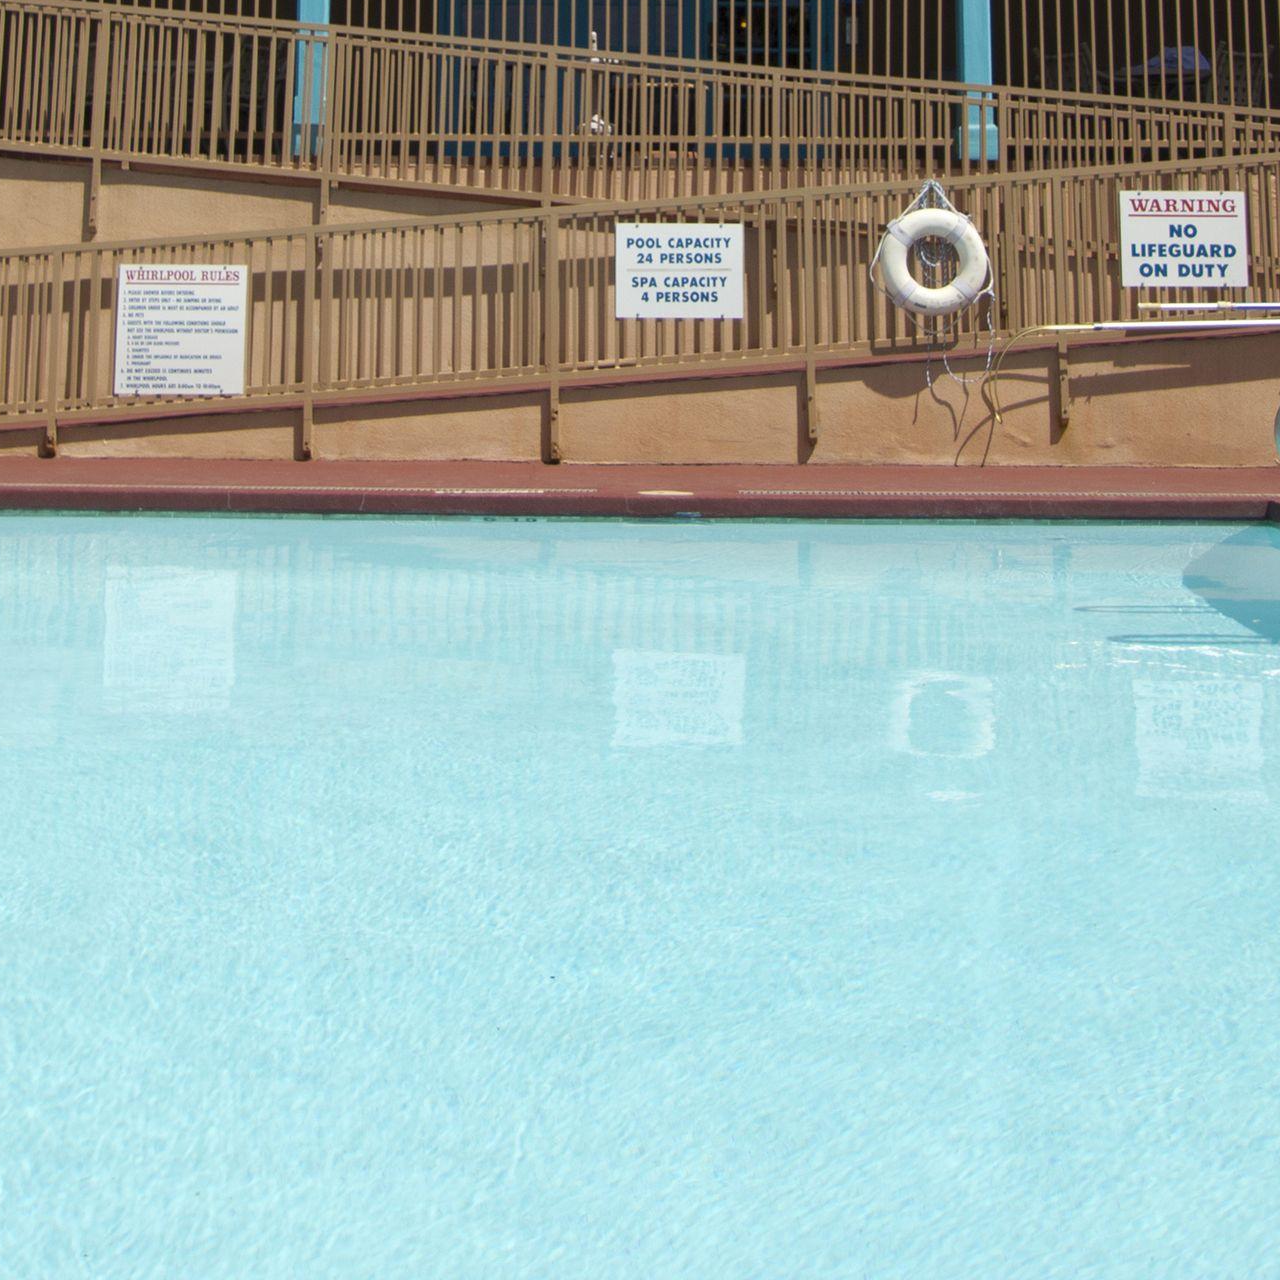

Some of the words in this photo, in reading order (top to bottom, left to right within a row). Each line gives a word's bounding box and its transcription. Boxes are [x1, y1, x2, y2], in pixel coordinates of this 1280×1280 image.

[1129, 198, 1237, 213] WARNING
[1169, 224, 1198, 238] NO
[626, 237, 662, 249] POOL
[667, 237, 732, 249] CAPACITY
[1130, 243, 1237, 258] LIFEGUARD
[637, 252, 654, 264] 24
[660, 252, 723, 264] PERSONS
[126, 269, 197, 281] WHIRLPOOL
[201, 270, 240, 282] RULES
[1139, 263, 1168, 277] ON
[1178, 263, 1229, 278] DUTY
[631, 276, 658, 288] SPA
[663, 276, 728, 288] CAPACITY
[641, 291, 650, 303] 4
[656, 291, 719, 303] PERSONS
